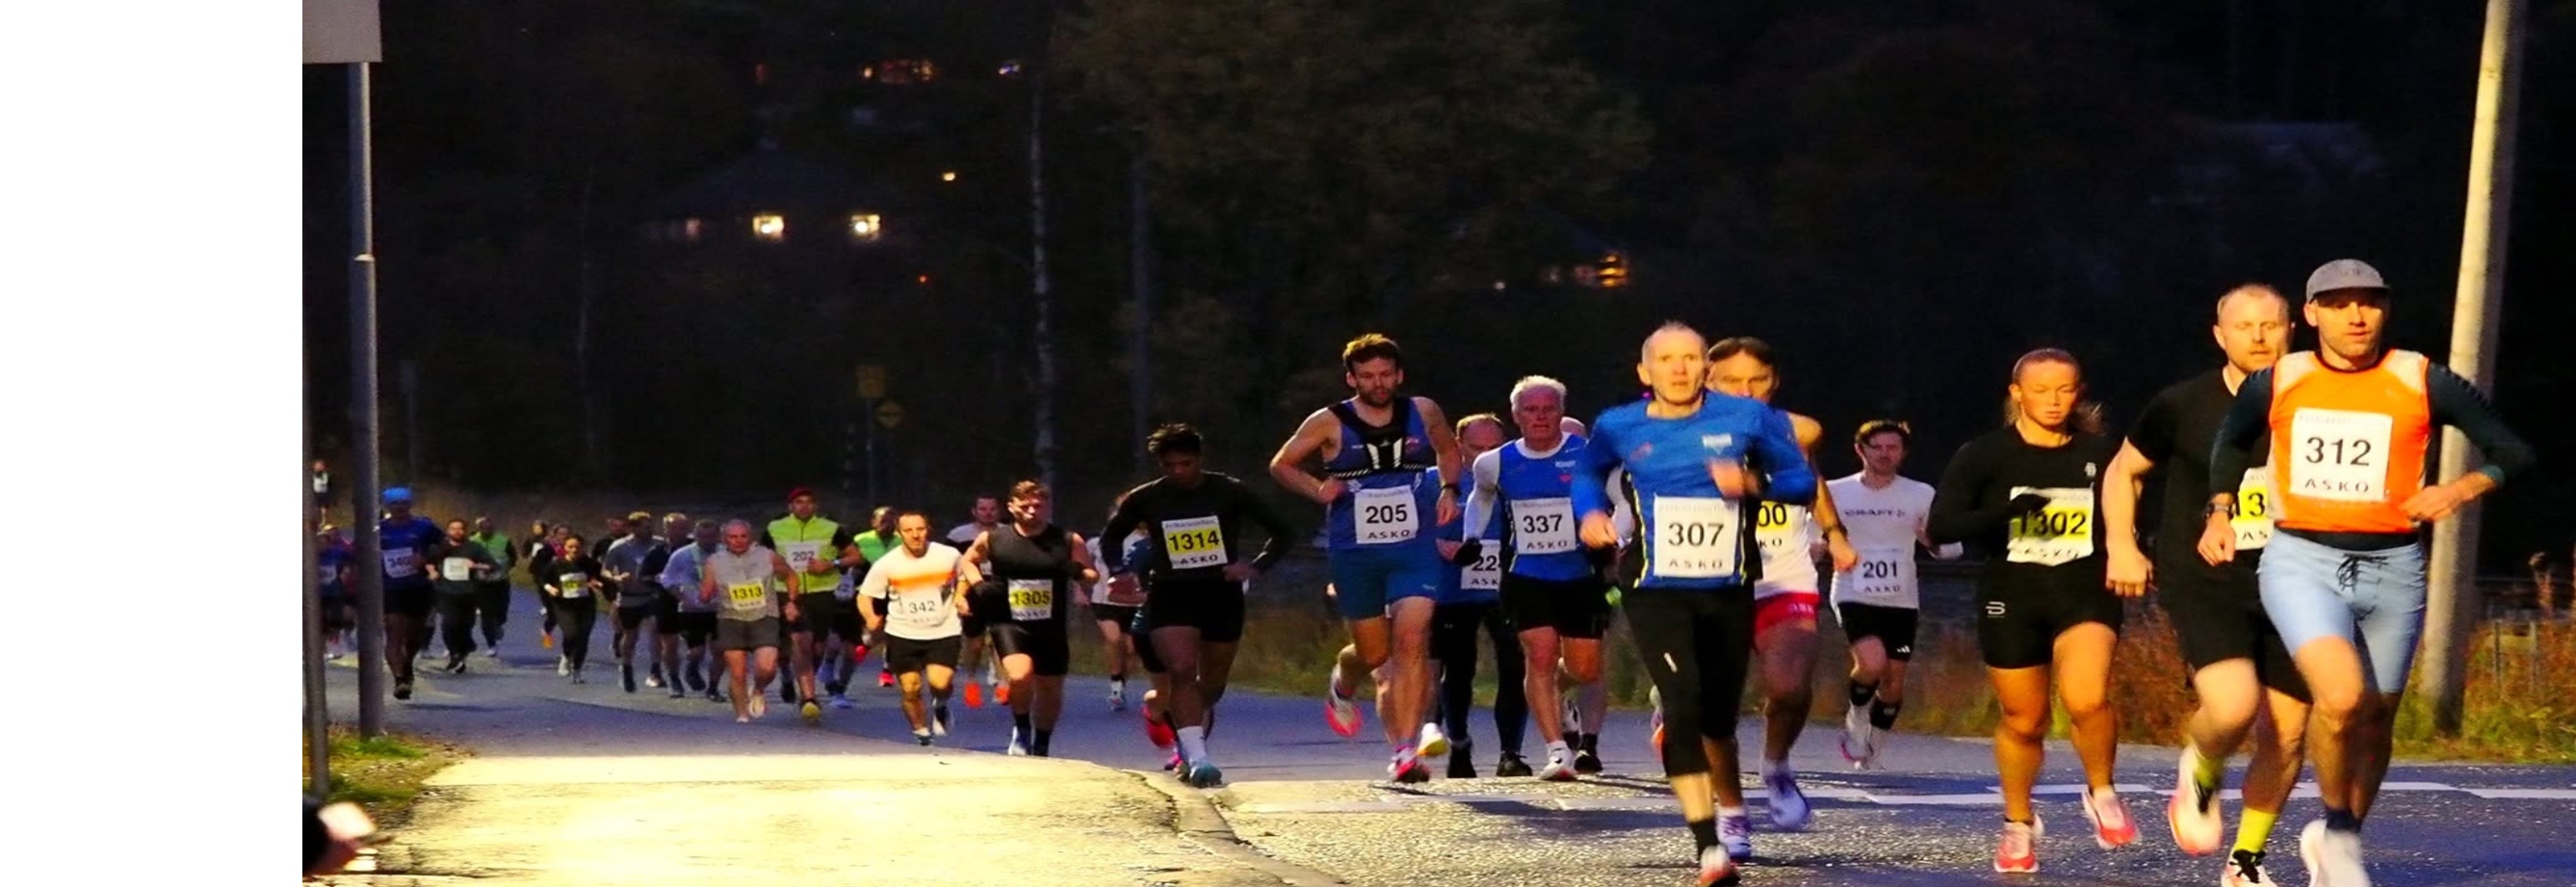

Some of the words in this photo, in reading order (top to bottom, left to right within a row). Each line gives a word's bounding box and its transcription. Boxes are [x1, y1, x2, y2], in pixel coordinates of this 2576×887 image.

[2305, 436, 2372, 466] 312
[2304, 478, 2369, 493] ASKO
[2232, 492, 2266, 518] 13
[1366, 504, 1408, 524] 205
[1757, 503, 1787, 527] 00
[1522, 513, 1563, 534] 337
[2020, 510, 2087, 539] 1302
[1169, 530, 1219, 551] 1314
[1367, 530, 1411, 539] ASKO
[1668, 522, 1725, 547] 307
[1759, 537, 1782, 548] KO
[2242, 531, 2269, 541] AS
[1526, 540, 1568, 550] ASKO
[792, 551, 815, 561] 202
[1180, 554, 1218, 564] ASKO
[1471, 555, 1501, 571] 22
[1669, 559, 1724, 570] ASKO
[1862, 561, 1897, 578] 201
[733, 586, 763, 599] 1313
[1013, 589, 1051, 606] 1305
[908, 600, 936, 613] 342
